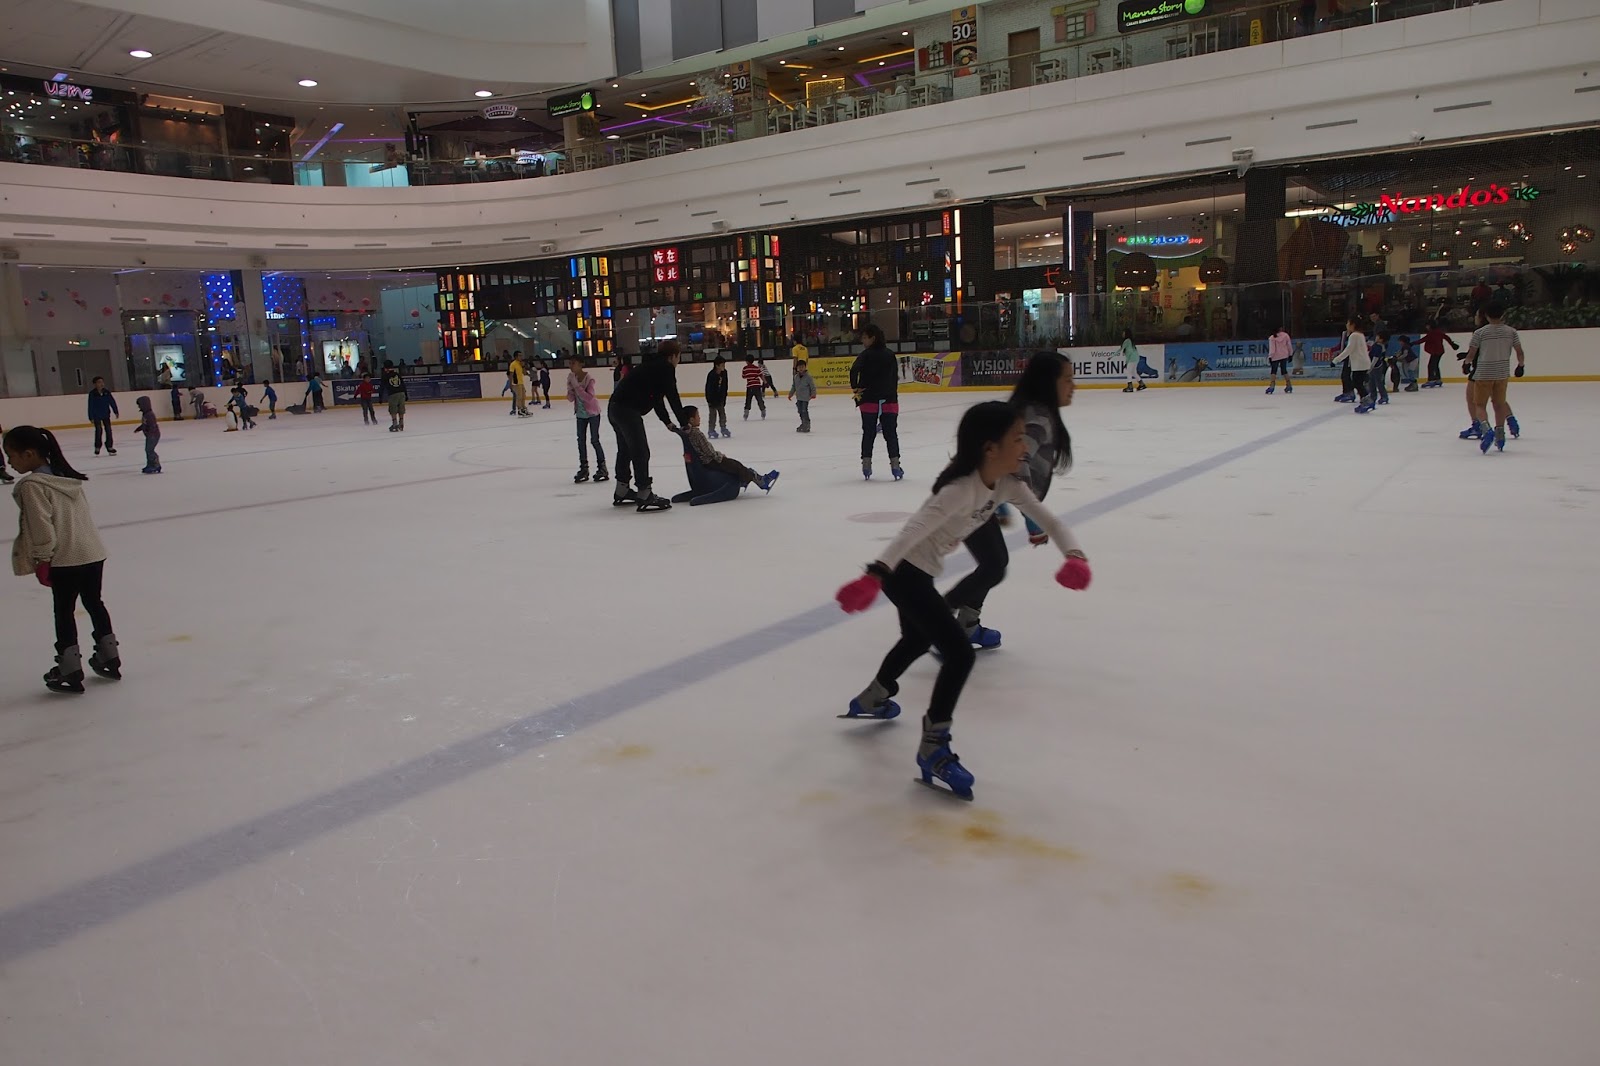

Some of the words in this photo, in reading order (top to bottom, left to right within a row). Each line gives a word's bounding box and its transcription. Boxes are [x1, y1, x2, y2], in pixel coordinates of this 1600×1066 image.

[1123, 7, 1158, 21] Manna
[1158, 1, 1183, 14] Story
[1376, 183, 1511, 217] Nando's
[1218, 345, 1244, 355] THE
[1248, 344, 1270, 354] RIN
[973, 359, 1015, 371] VISION
[1072, 362, 1092, 375] HE
